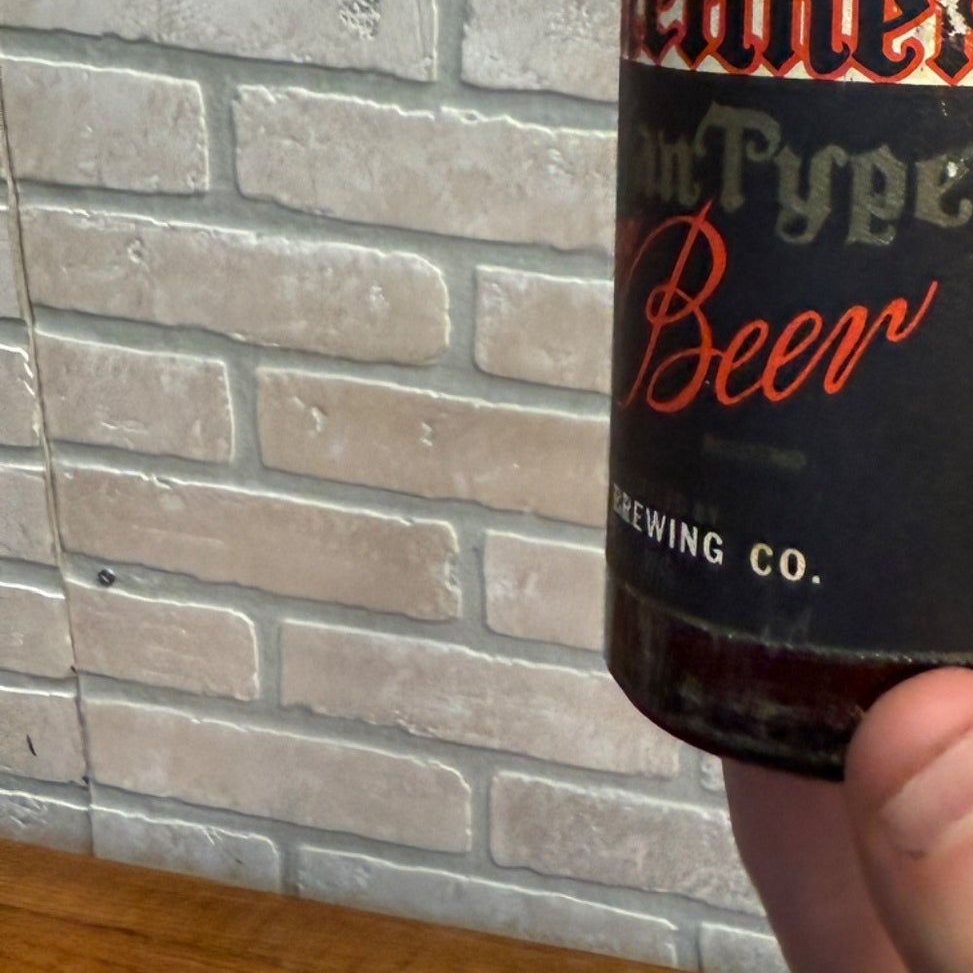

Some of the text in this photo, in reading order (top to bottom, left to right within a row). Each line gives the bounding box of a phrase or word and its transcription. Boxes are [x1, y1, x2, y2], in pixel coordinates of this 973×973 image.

[695, 100, 973, 247] Type
[619, 198, 938, 413] Beer
[612, 482, 724, 566] BREWING
[749, 542, 821, 585] CO.
